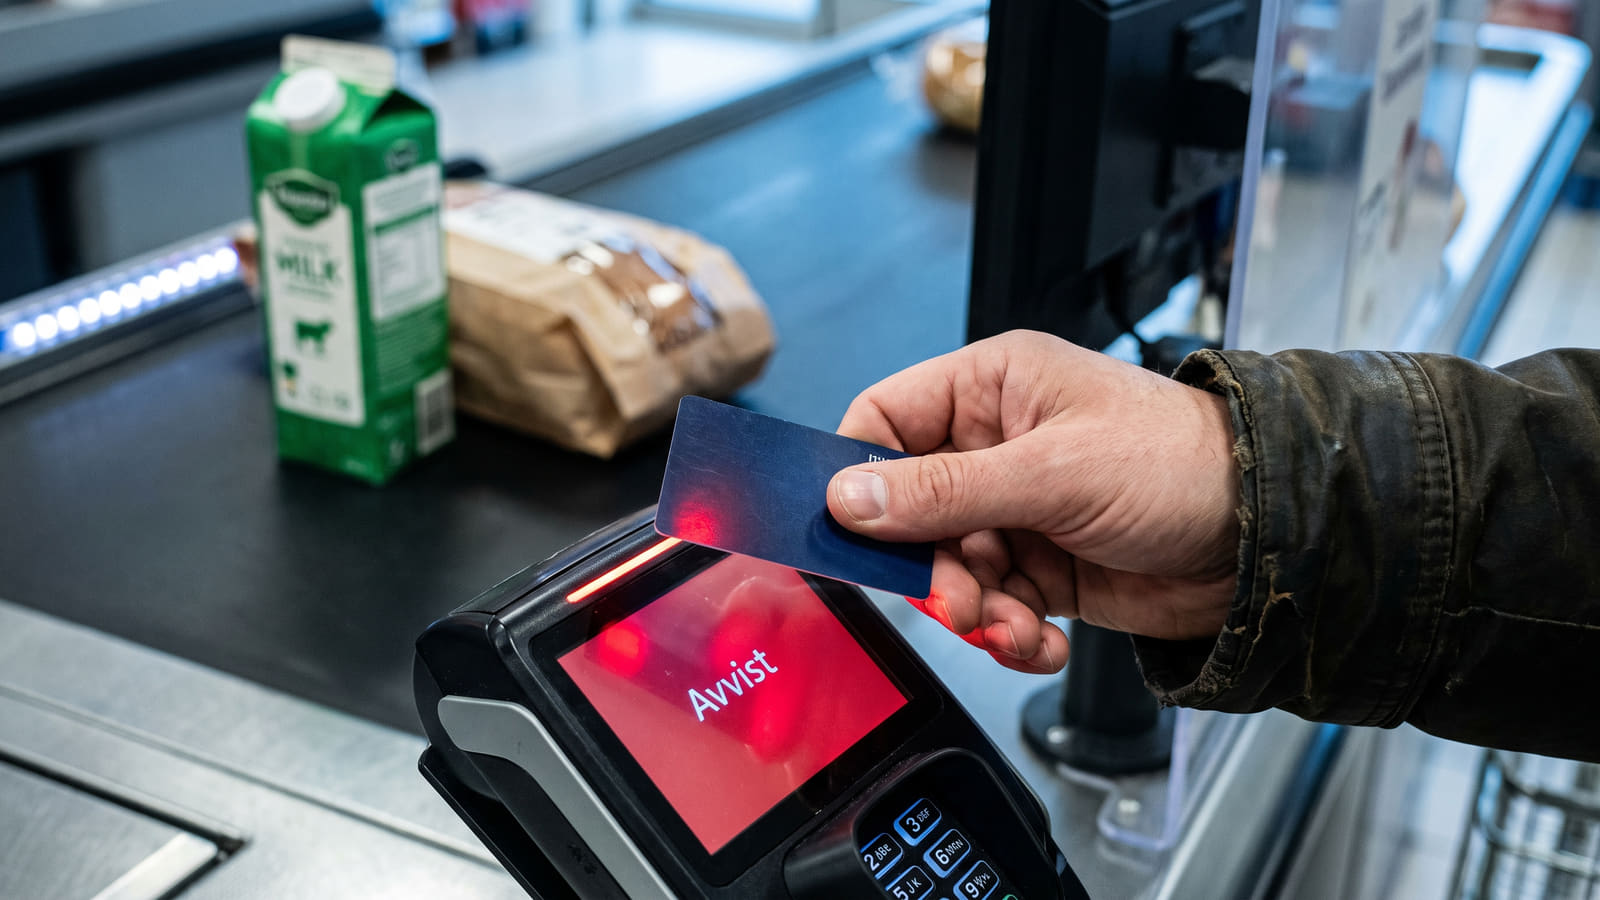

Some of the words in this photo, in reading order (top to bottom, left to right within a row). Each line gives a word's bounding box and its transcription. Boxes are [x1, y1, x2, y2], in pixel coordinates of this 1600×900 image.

[687, 648, 779, 722] Avvist
[905, 817, 921, 833] 3
[863, 853, 880, 871] 2
[935, 849, 950, 865] 6
[892, 886, 909, 900] 5
[965, 882, 980, 899] 9
